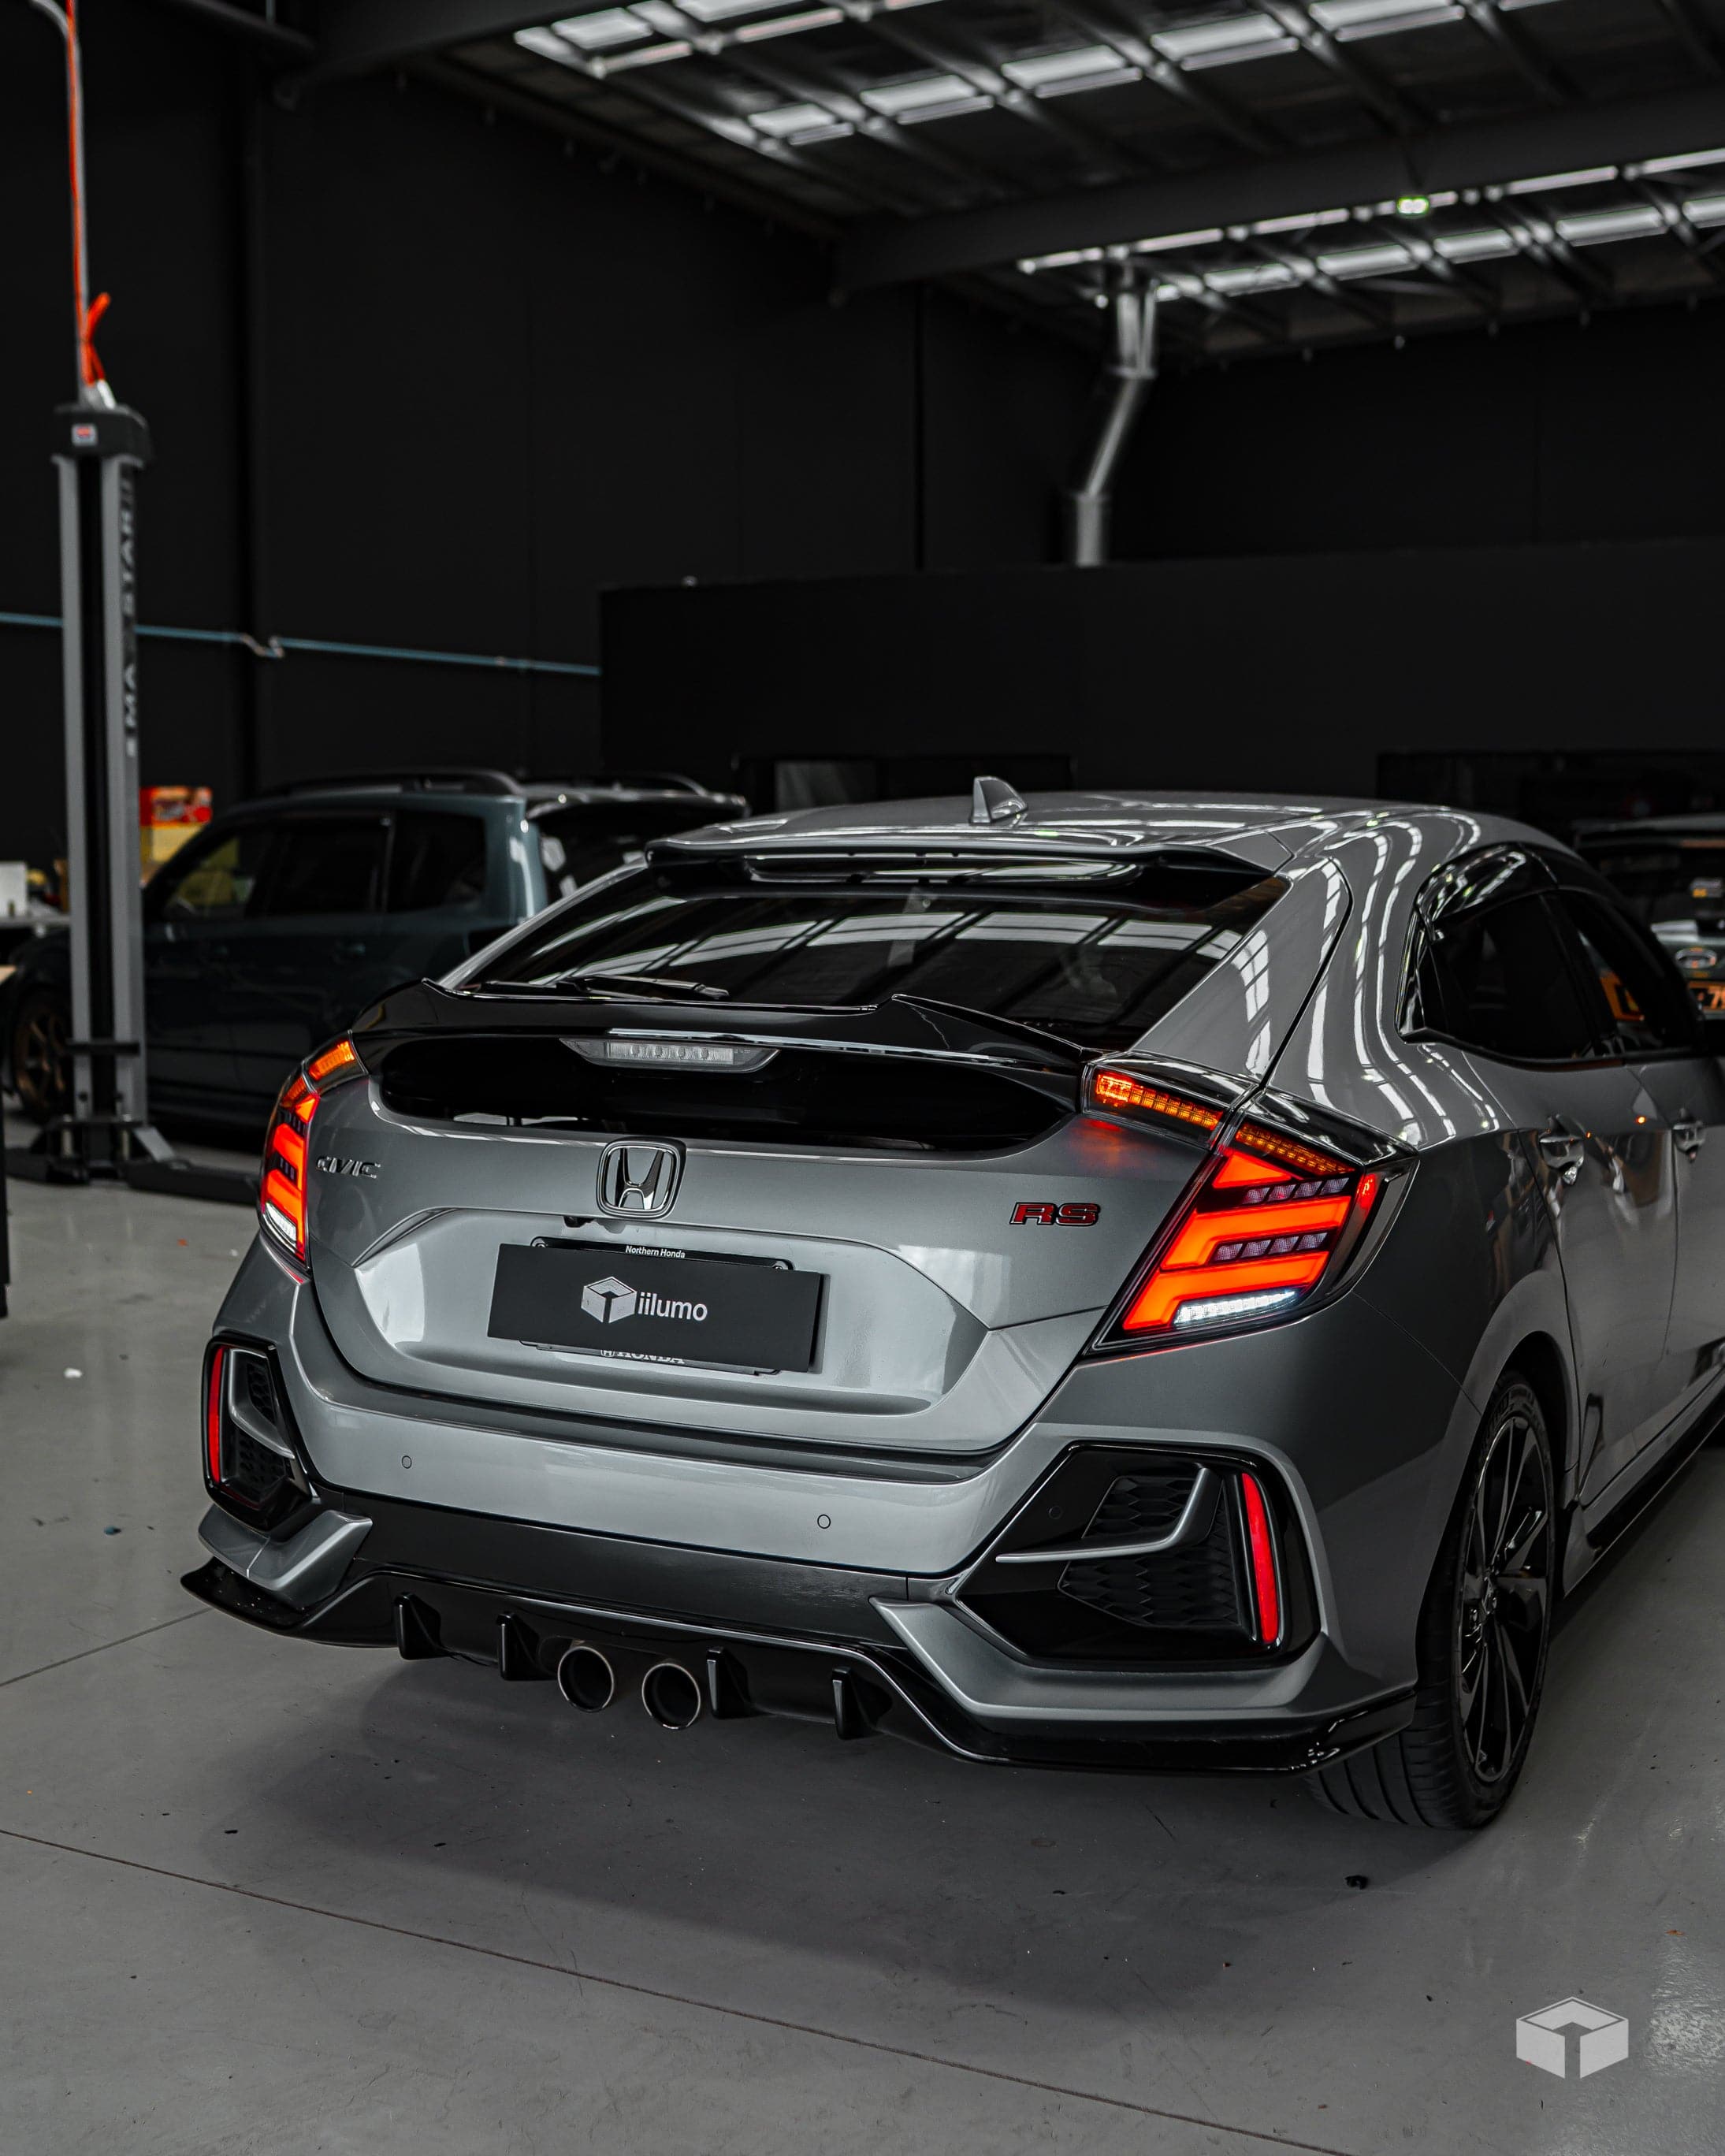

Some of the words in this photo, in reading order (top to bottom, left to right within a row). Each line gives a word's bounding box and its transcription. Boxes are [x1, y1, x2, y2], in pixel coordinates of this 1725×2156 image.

[317, 1156, 381, 1179] CIVIC
[1009, 1202, 1101, 1227] RS
[625, 1245, 660, 1256] Northern
[660, 1248, 686, 1258] Honda
[638, 1292, 708, 1321] iilumo
